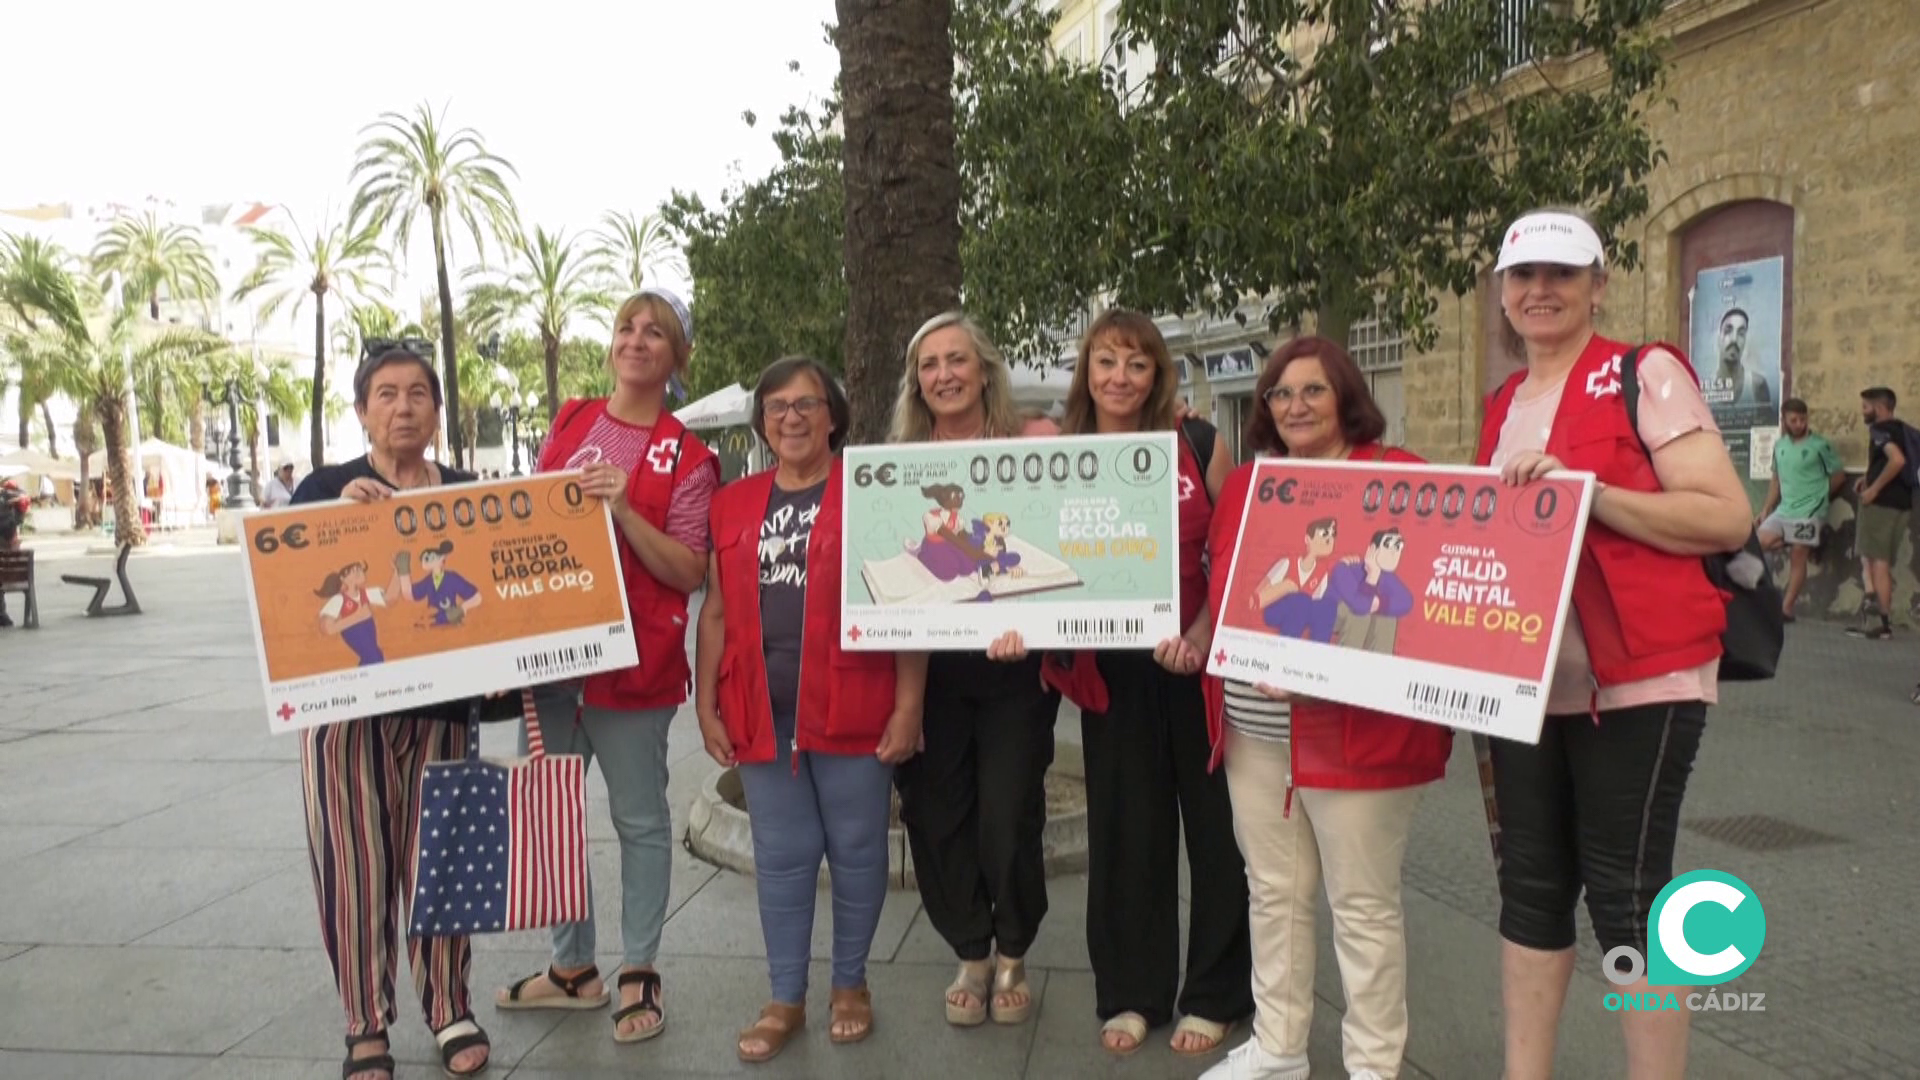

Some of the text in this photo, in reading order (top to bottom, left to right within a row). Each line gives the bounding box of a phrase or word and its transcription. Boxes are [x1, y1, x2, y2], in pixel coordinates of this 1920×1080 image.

[1524, 223, 1573, 235] Cruz Roja
[1133, 447, 1151, 474] 0
[854, 462, 898, 488] 6€
[564, 481, 583, 507] 0
[1258, 476, 1298, 504] 6€
[1534, 486, 1558, 521] 0
[255, 522, 310, 554] 6€
[1059, 521, 1147, 539] ESCOLAR
[1794, 523, 1816, 540] 23
[491, 539, 568, 564] FUTURO
[1058, 538, 1158, 561] VALE ORO
[1441, 543, 1496, 559] CUIDAR LA
[492, 555, 583, 582] LABORAL
[1432, 556, 1507, 582] SALUD
[496, 570, 594, 600] VALE ORO
[1425, 577, 1516, 607] MENTAL
[1423, 599, 1543, 640] VALE ORO
[866, 628, 912, 639] Cruz Roja
[1230, 653, 1270, 672] Cruz Roja
[374, 681, 434, 699] Sorteo de Oro
[301, 694, 358, 713] Cruz Roja
